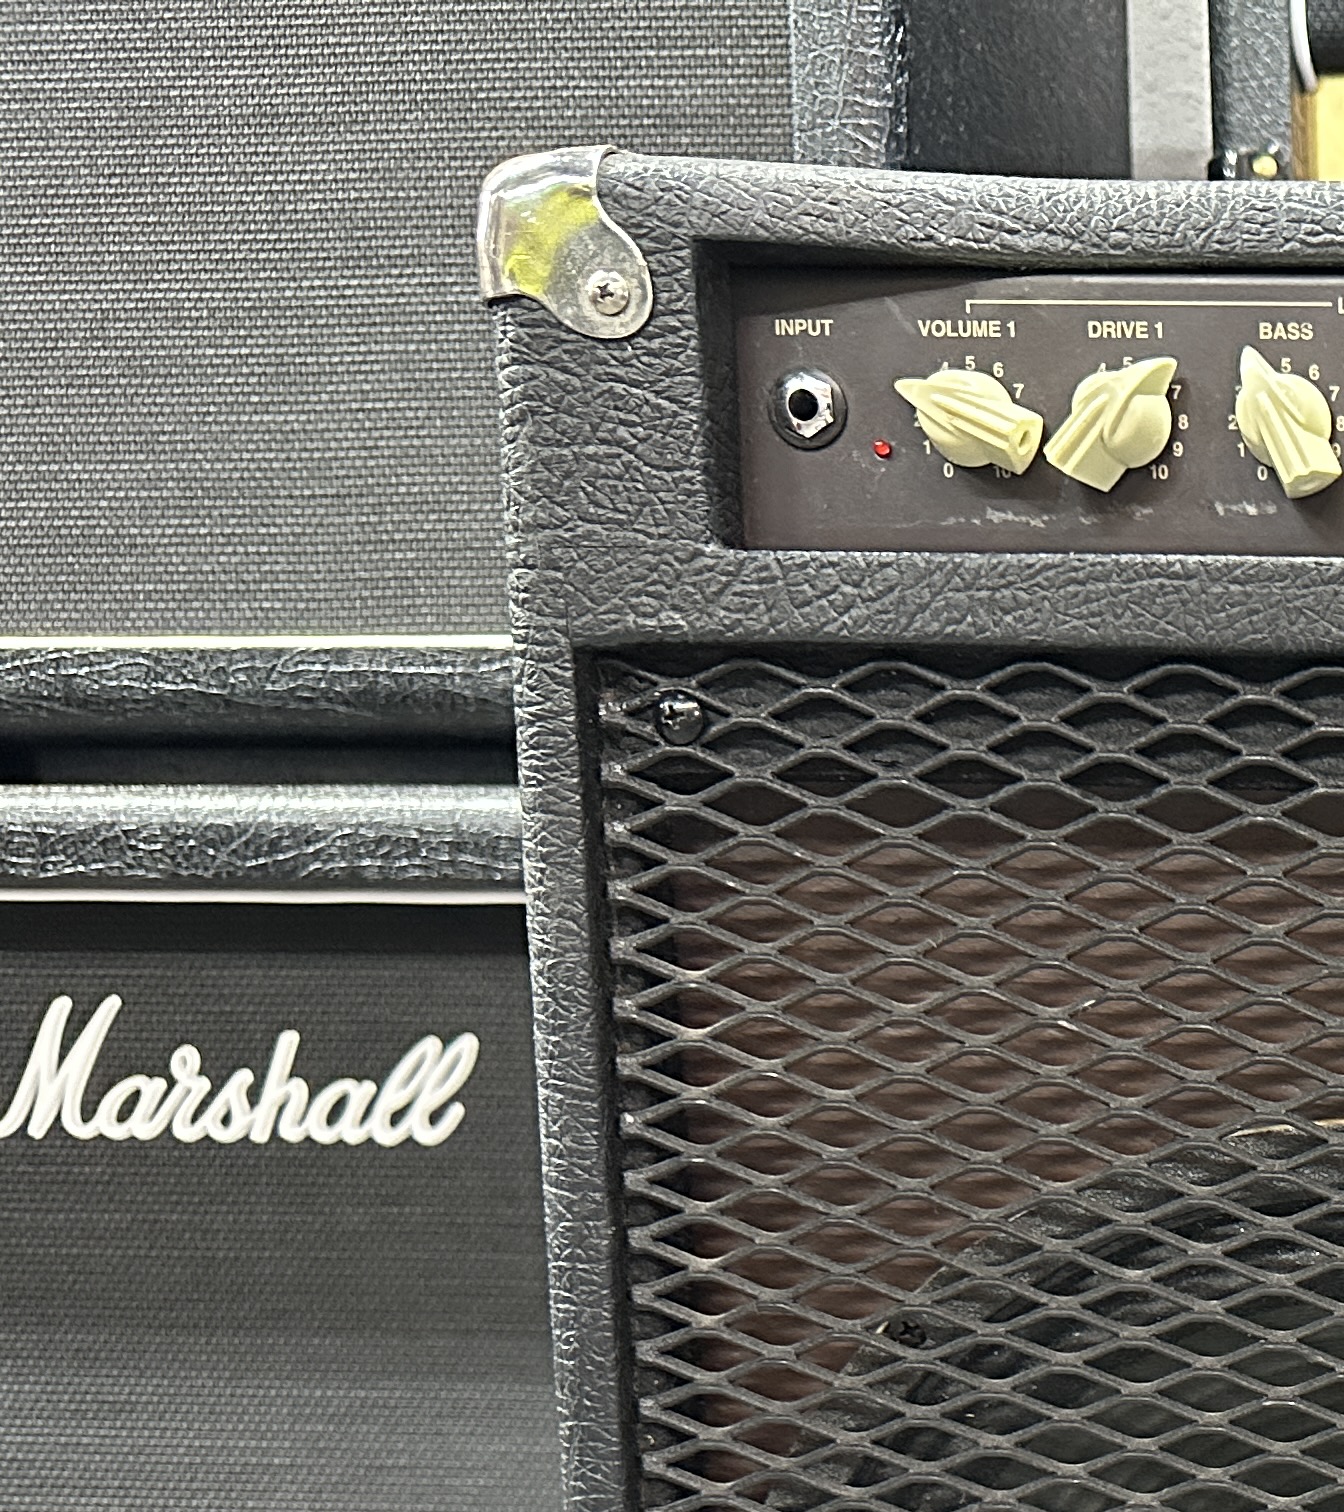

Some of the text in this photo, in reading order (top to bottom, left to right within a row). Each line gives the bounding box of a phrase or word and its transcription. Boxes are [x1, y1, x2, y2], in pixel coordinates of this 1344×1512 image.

[774, 319, 834, 336] INPUT
[918, 319, 1016, 338] VOLUME 1
[1087, 321, 1163, 339] DRIVE 1
[1259, 322, 1314, 340] BASS
[965, 356, 975, 370] 5
[993, 362, 1004, 378] 6
[1281, 358, 1291, 373] 5
[1308, 364, 1320, 381] 6
[1013, 383, 1025, 399] 7
[1171, 385, 1182, 400] 7
[1329, 386, 1340, 401] 7
[1177, 414, 1189, 430] 8
[1228, 415, 1238, 430] 2
[923, 440, 931, 454] 1
[1172, 441, 1183, 457] 9
[1237, 442, 1245, 457] 1
[943, 463, 954, 478] 0
[1151, 464, 1168, 480] 10
[1257, 466, 1268, 481] 0
[0, 993, 480, 1147] Marshall
